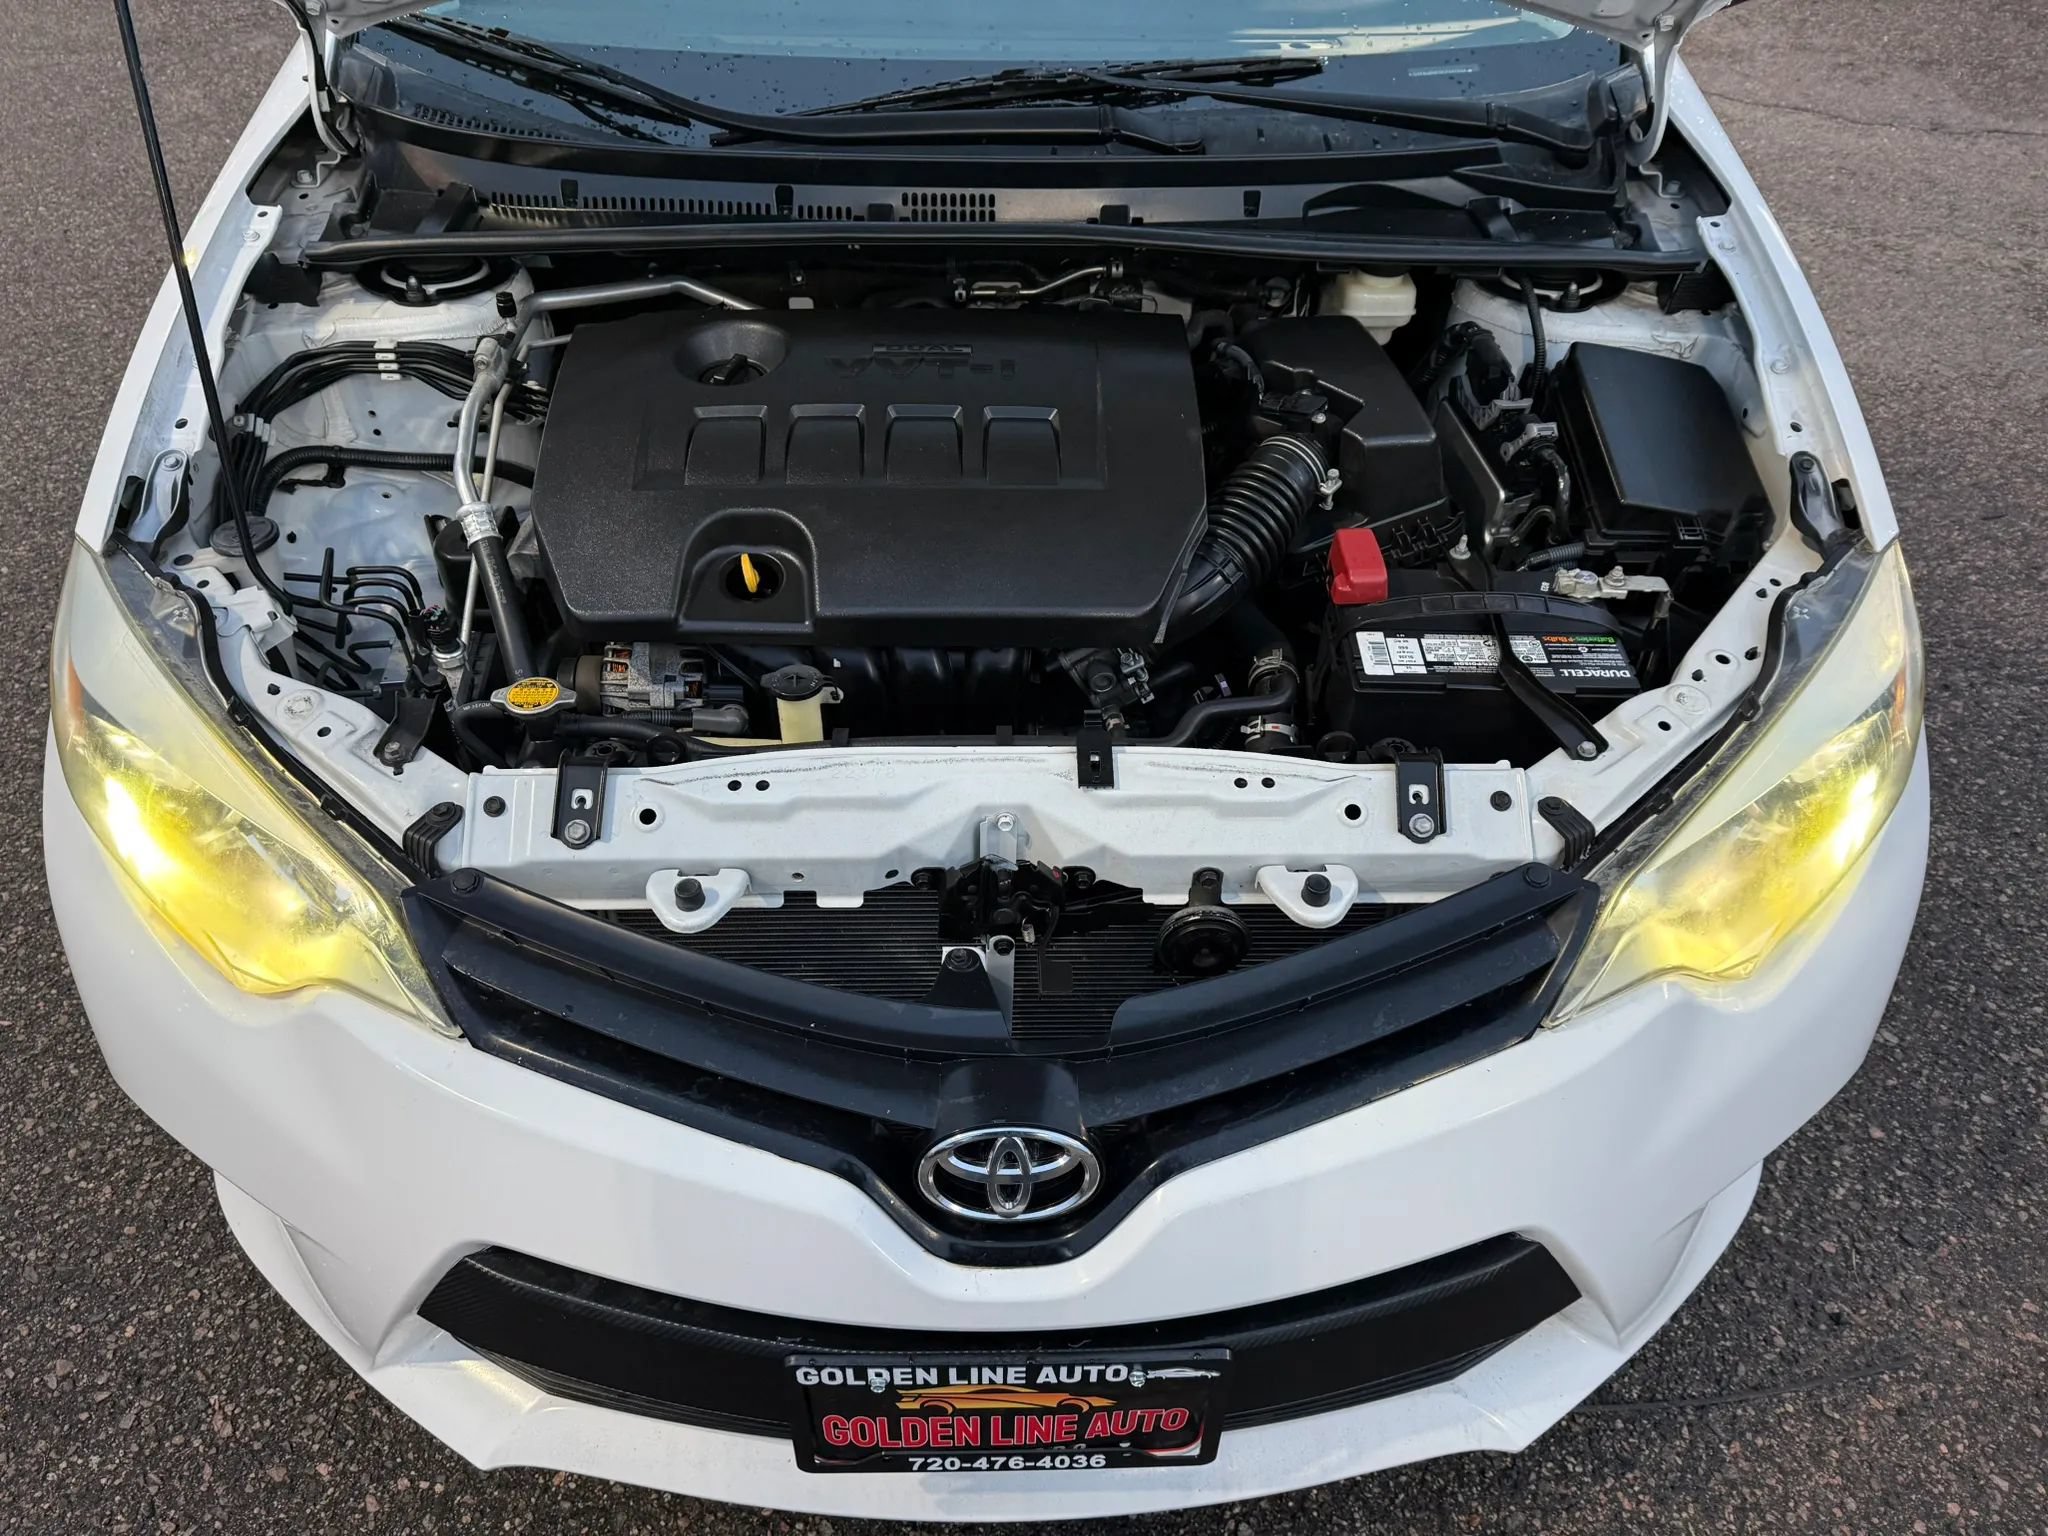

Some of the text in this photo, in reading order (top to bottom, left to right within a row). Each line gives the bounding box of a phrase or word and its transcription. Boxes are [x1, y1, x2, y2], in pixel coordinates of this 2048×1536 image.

[1559, 668, 1632, 678] DURACELL
[795, 1365, 1129, 1386] GOLDEN LINE AUTO
[821, 1407, 1190, 1448] GOLDEN LINE AUTO
[908, 1454, 1107, 1471] 720-476-4036
